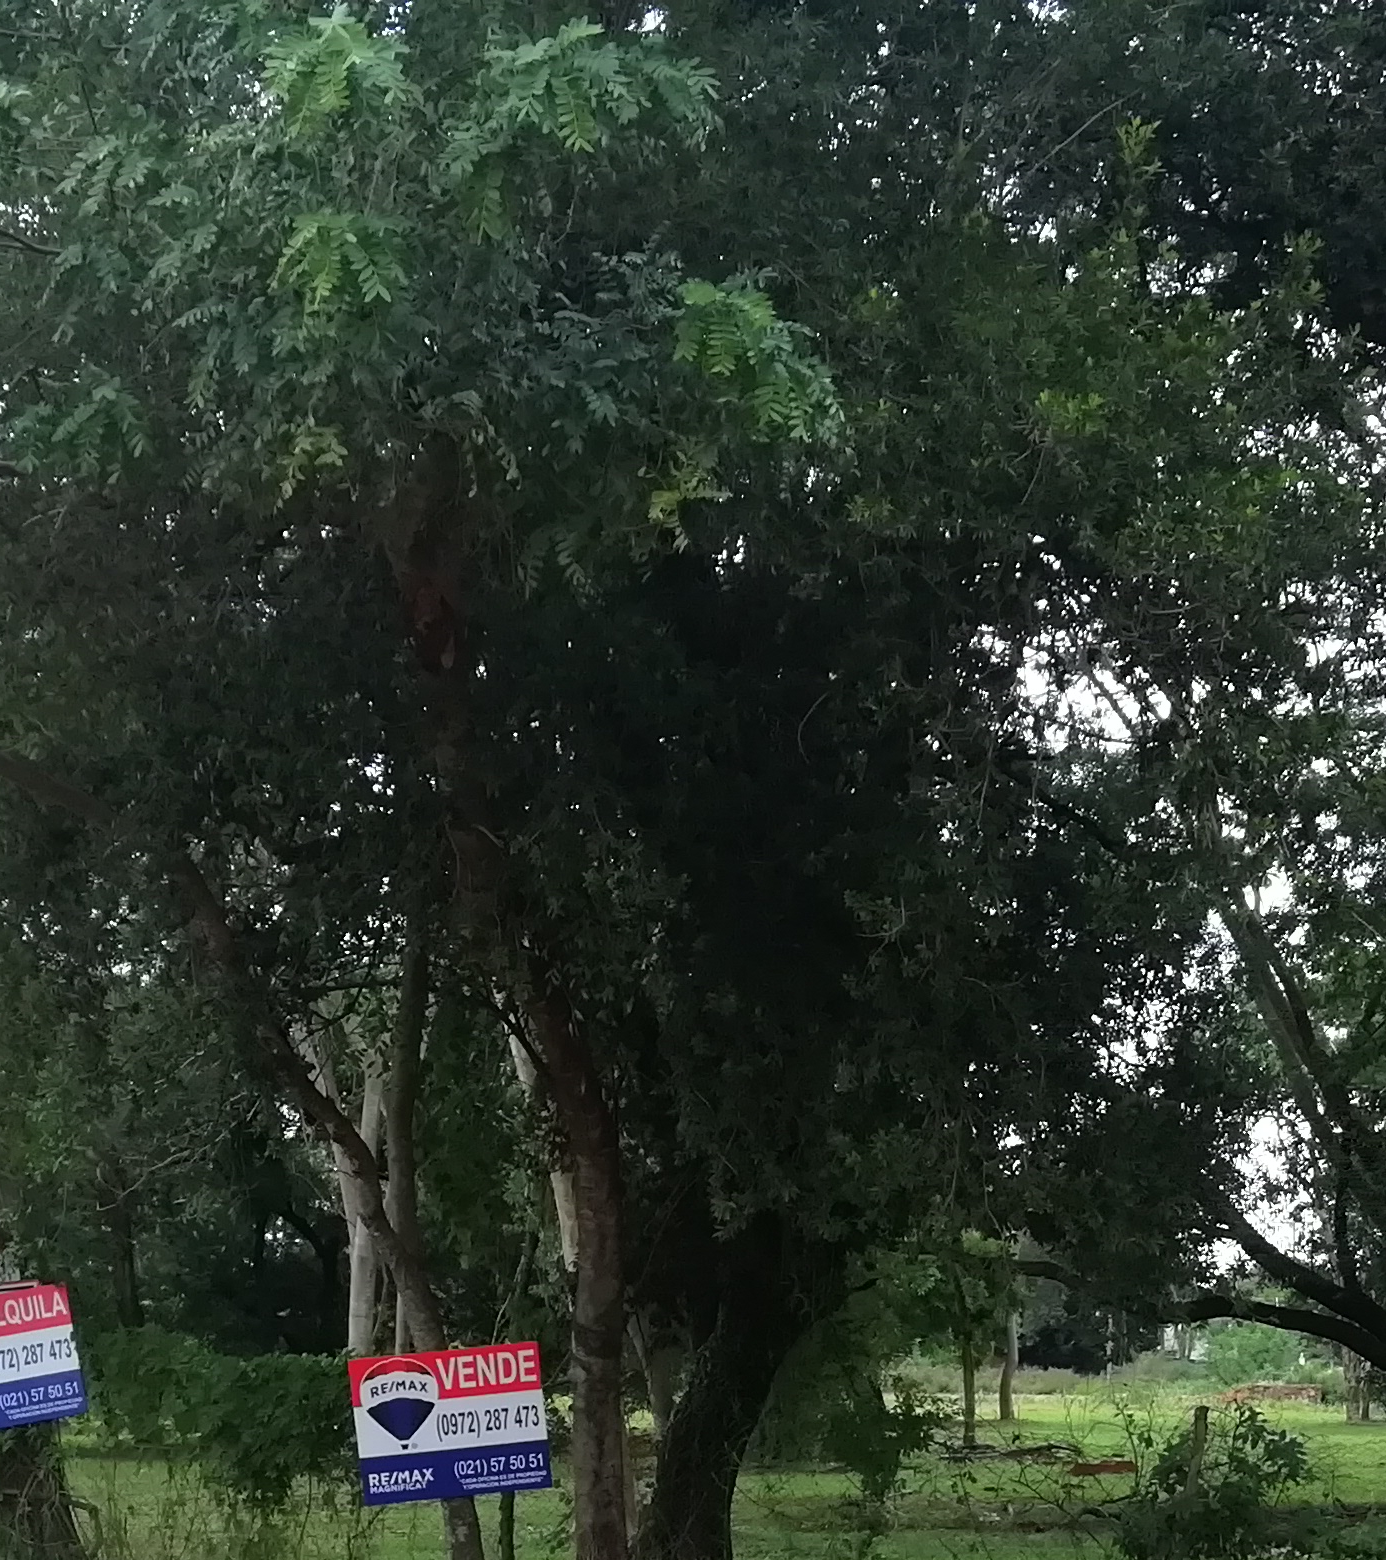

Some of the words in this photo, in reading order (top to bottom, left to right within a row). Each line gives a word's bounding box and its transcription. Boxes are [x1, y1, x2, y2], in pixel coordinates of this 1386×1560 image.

[22, 1343, 44, 1366] 287
[49, 1338, 72, 1361] 473
[436, 1349, 537, 1390] VENDE
[0, 1390, 29, 1410] (021)
[31, 1387, 45, 1401] 57
[48, 1384, 63, 1399] 50
[65, 1381, 79, 1395] 51
[370, 1380, 428, 1398] RE/MAX
[436, 1410, 481, 1442] (0972)
[484, 1407, 509, 1432] 287
[514, 1404, 540, 1428] 473
[368, 1467, 435, 1487] RE/MAX
[454, 1459, 488, 1479] (021)
[490, 1457, 506, 1472] 57
[509, 1454, 525, 1470] 50
[529, 1453, 544, 1468] 51
